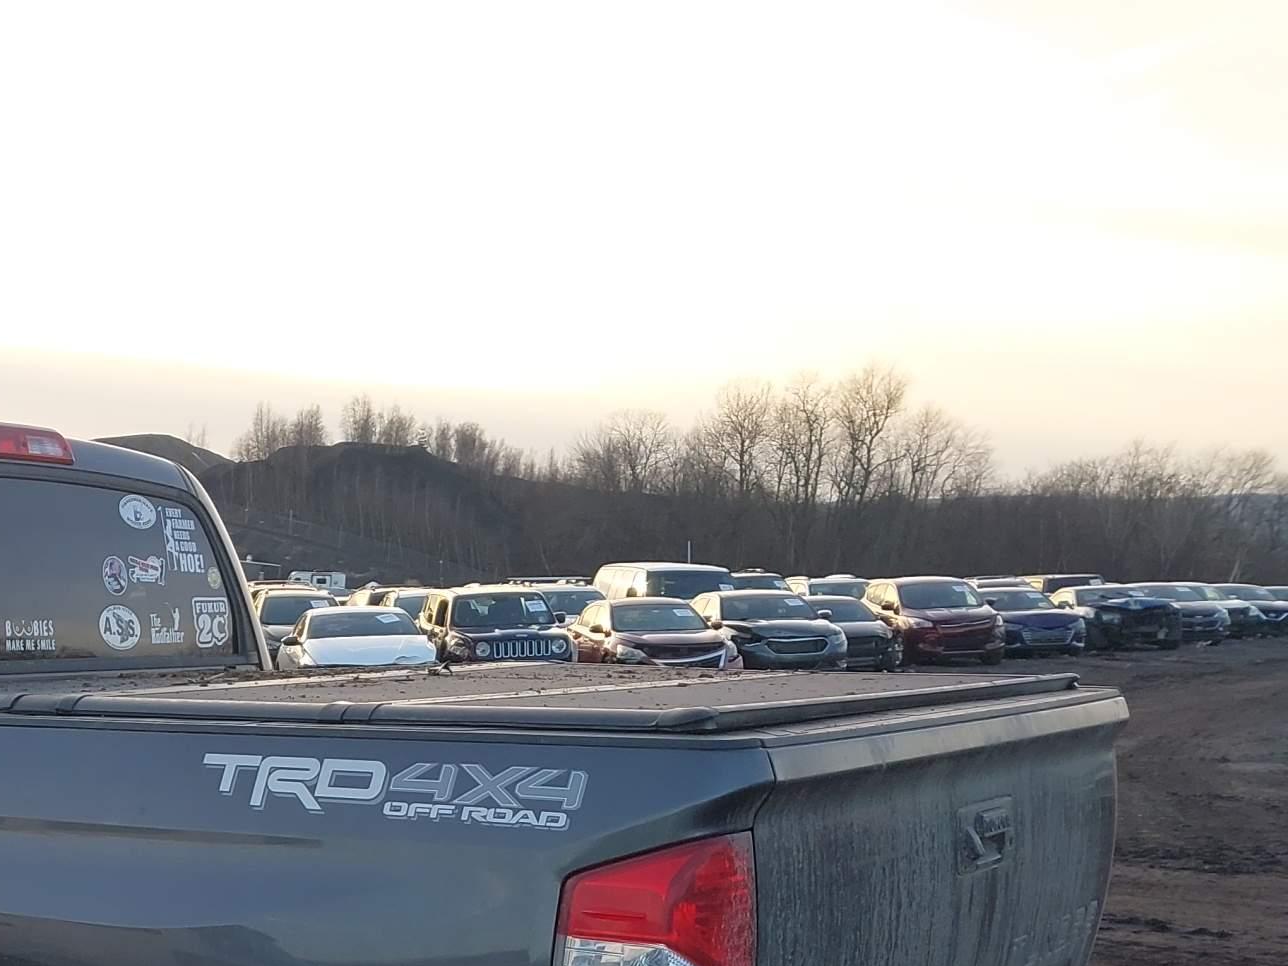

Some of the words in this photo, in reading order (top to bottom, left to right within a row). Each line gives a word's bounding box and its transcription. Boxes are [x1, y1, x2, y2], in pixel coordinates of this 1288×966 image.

[179, 553, 205, 573] HOE!
[5, 639, 25, 651] MAKE
[25, 639, 35, 651] ME
[36, 639, 56, 651] SMILE
[202, 753, 390, 816] TRD
[389, 762, 589, 811] 4X4
[383, 801, 458, 823] OFF
[461, 806, 570, 831] ROAD
